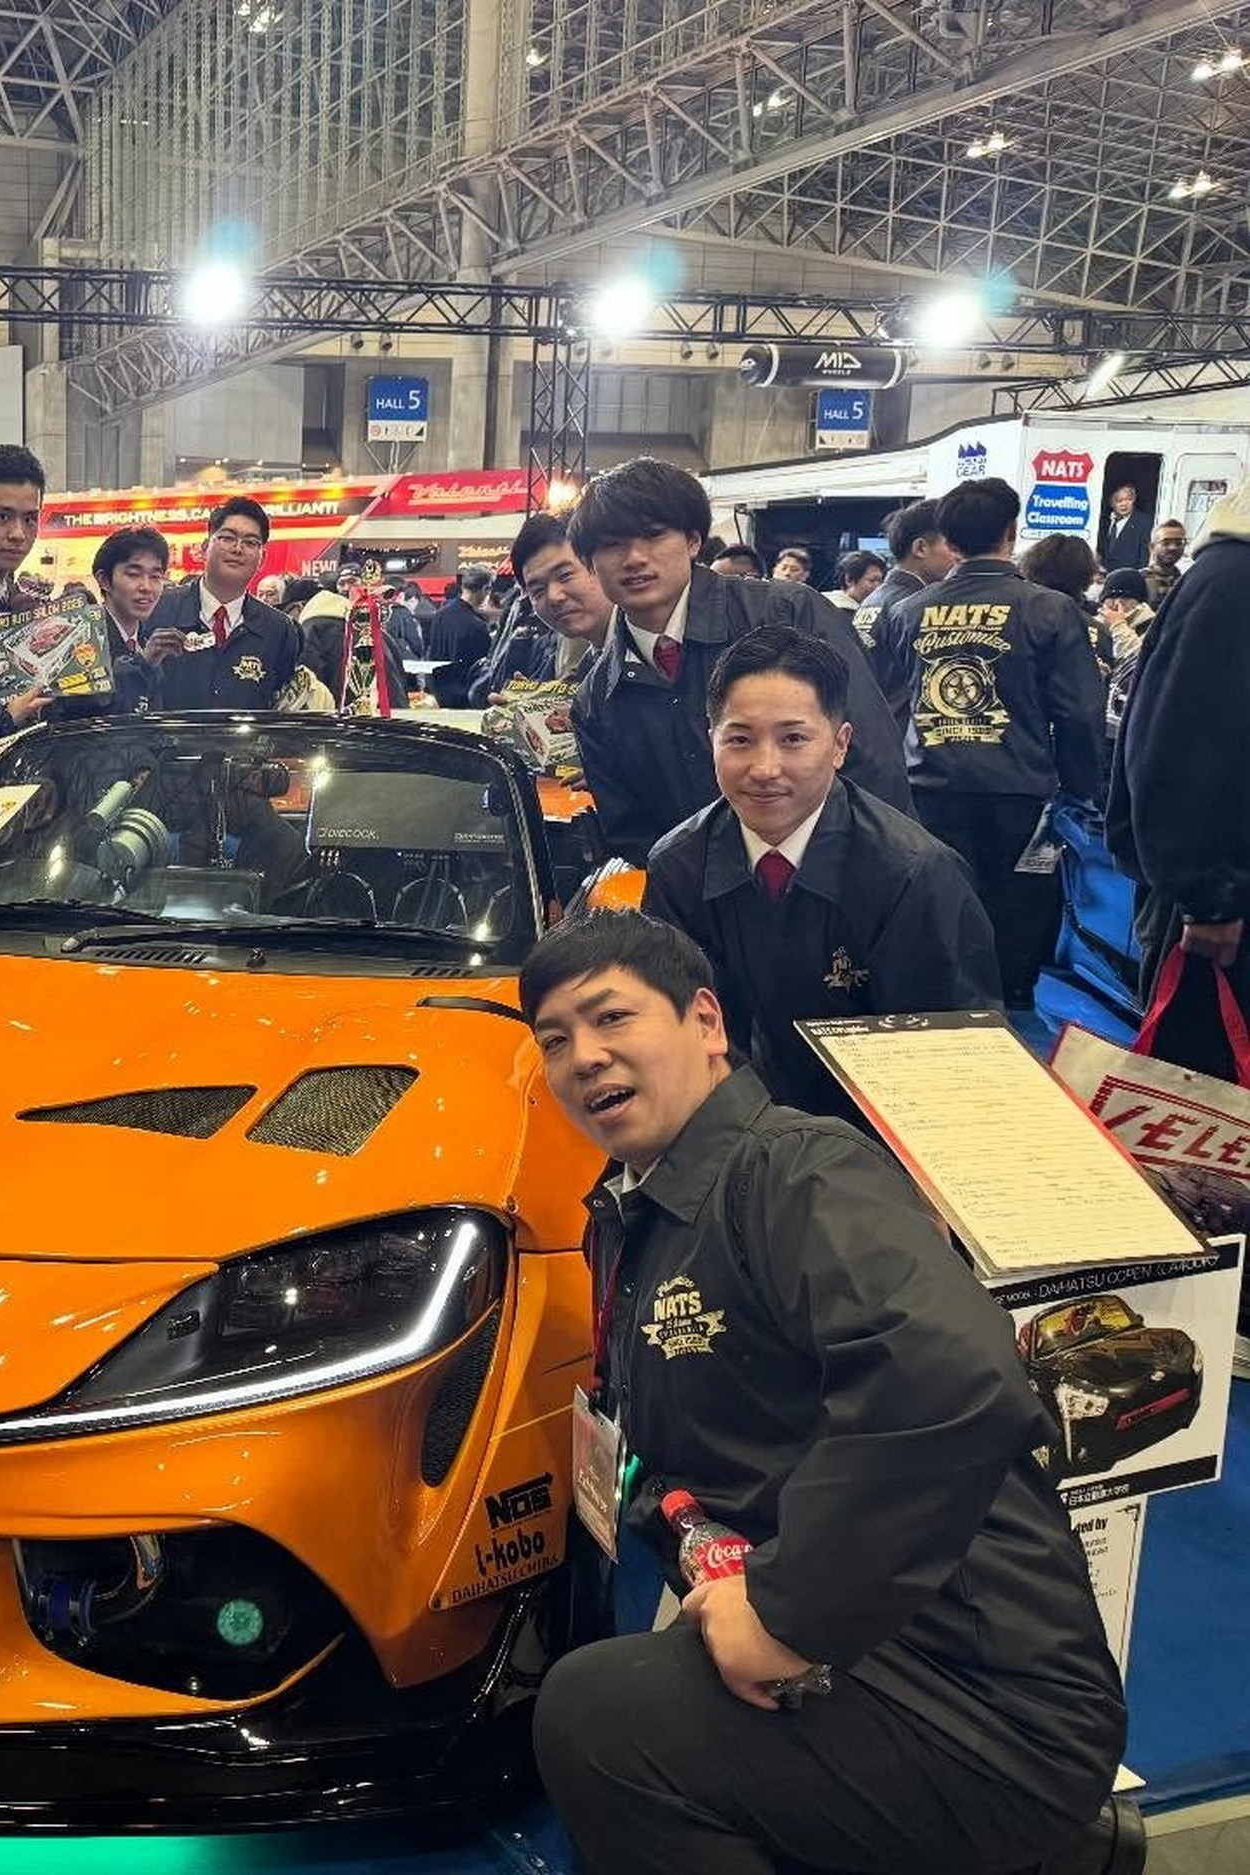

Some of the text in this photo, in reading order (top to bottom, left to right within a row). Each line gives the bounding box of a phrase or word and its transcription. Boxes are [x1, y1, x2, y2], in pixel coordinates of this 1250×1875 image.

[375, 389, 421, 410] HALL 5
[824, 401, 864, 420] HALL 5
[1041, 460, 1085, 478] NATS
[1032, 494, 1089, 511] Travelling
[63, 514, 92, 527] THE
[1027, 511, 1085, 526] Classroom
[919, 603, 1011, 628] NATS
[654, 1291, 703, 1322] NATS
[452, 1571, 516, 1602] DAIHATSU
